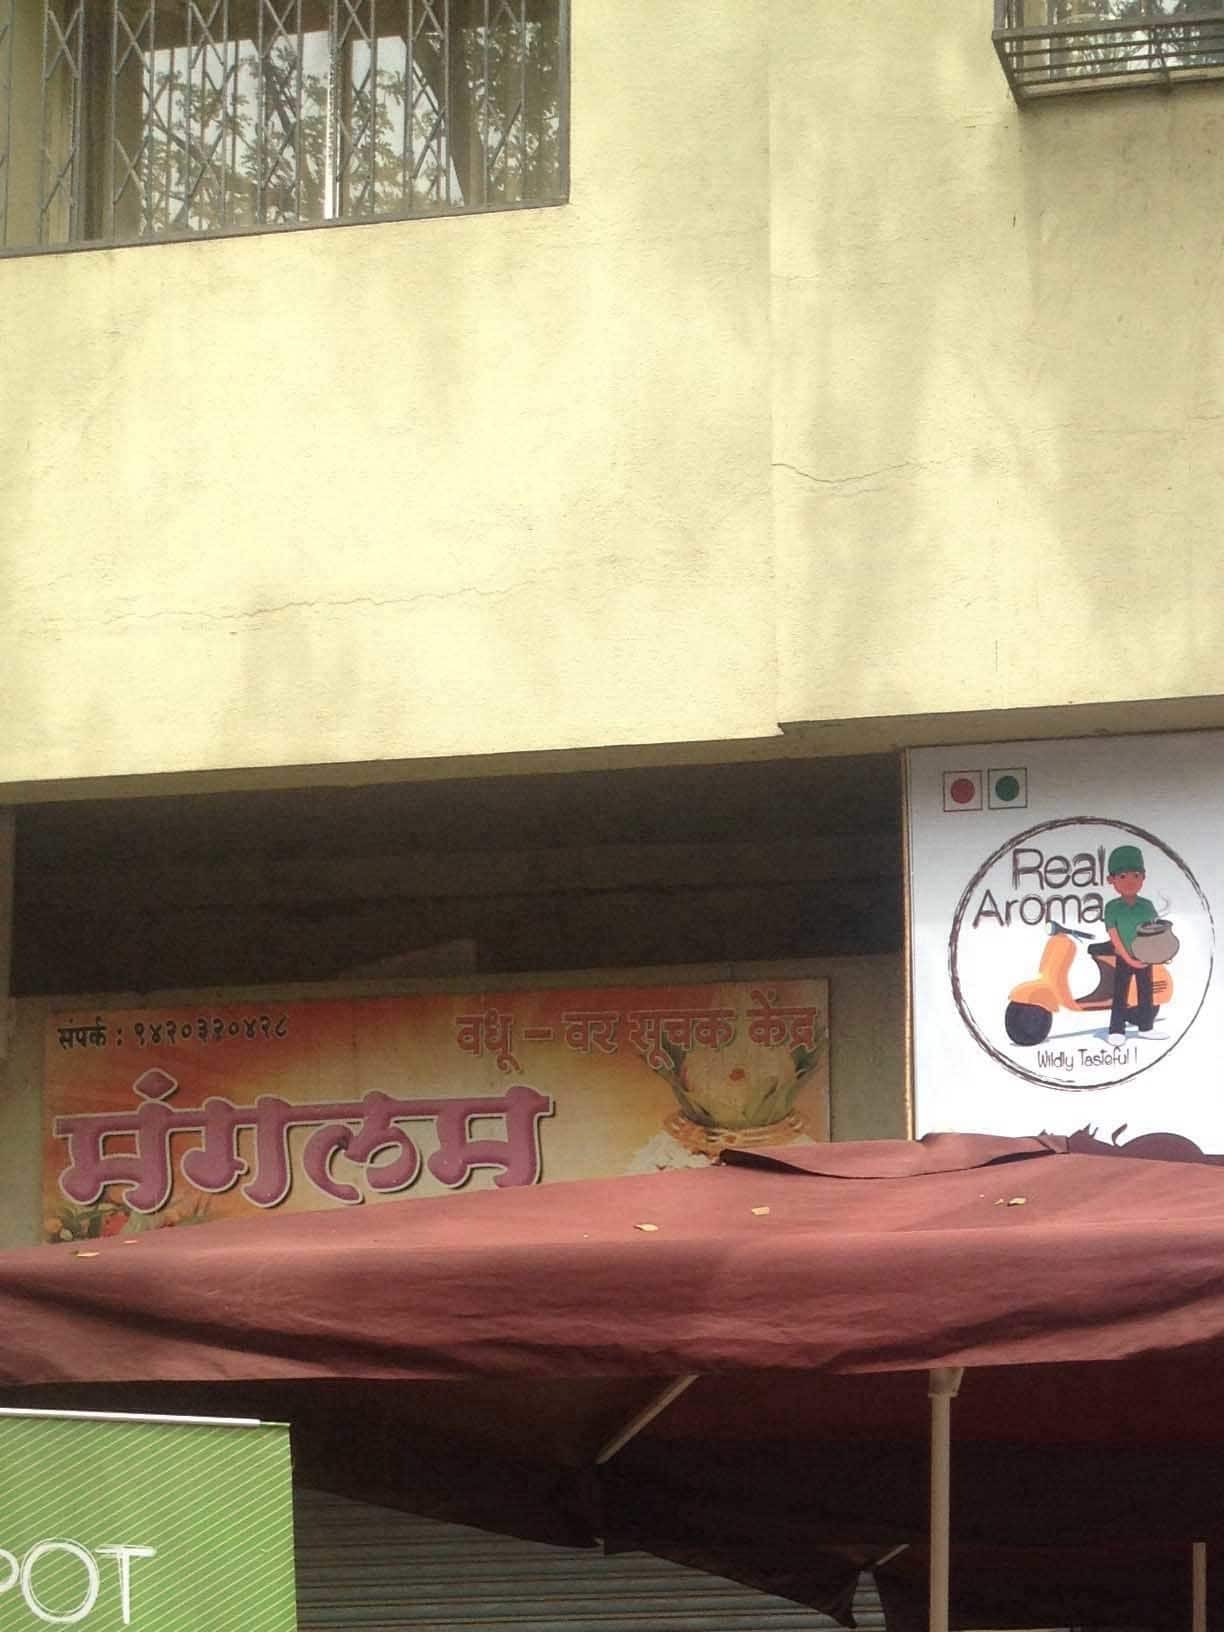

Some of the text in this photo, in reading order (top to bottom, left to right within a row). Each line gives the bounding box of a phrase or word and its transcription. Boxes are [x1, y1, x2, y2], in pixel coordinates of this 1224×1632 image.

[1011, 844, 1108, 891] Real
[972, 888, 1107, 929] Aroma
[560, 1010, 621, 1054] वर
[1037, 1050, 1074, 1072] Wildly
[53, 1067, 556, 1214] मंगलम
